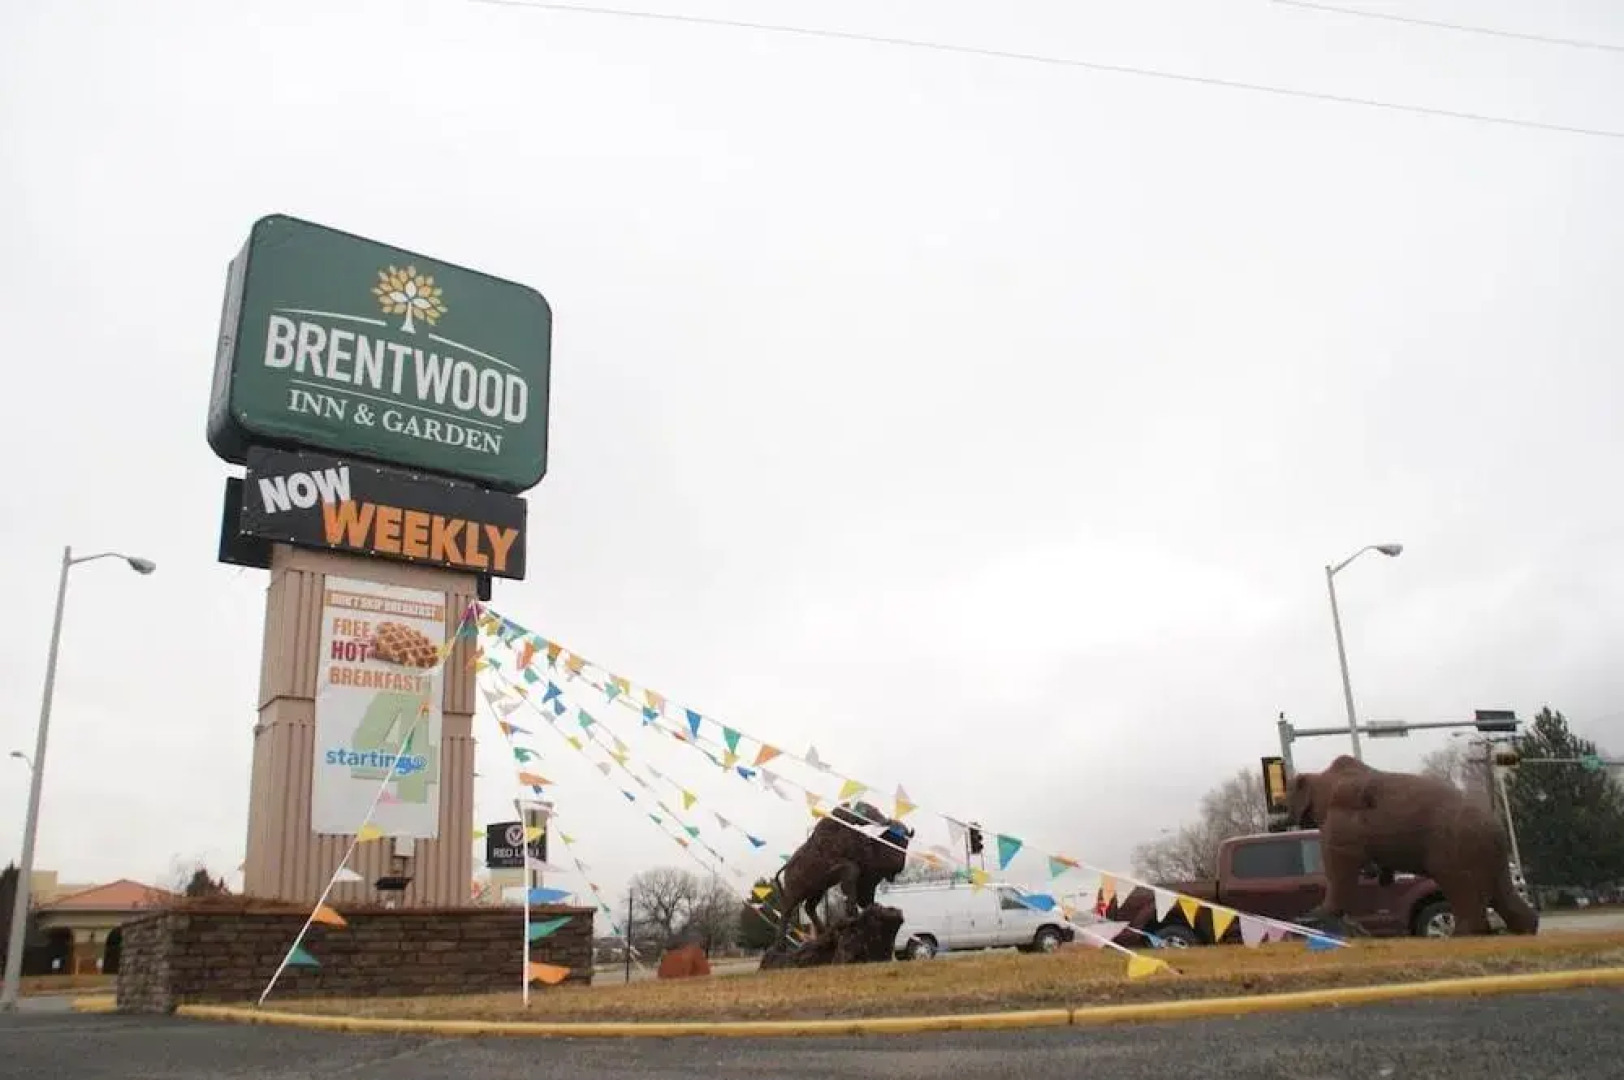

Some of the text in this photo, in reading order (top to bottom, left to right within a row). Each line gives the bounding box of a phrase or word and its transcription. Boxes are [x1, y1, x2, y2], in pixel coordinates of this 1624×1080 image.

[264, 315, 529, 424] BRENTWOOD
[287, 389, 503, 455] INN & GARDEN
[258, 466, 353, 514] NOW
[321, 500, 519, 572] WEEKLY
[331, 640, 368, 663] HOT
[332, 617, 371, 640] FREE
[329, 666, 422, 692] BREAKFAST
